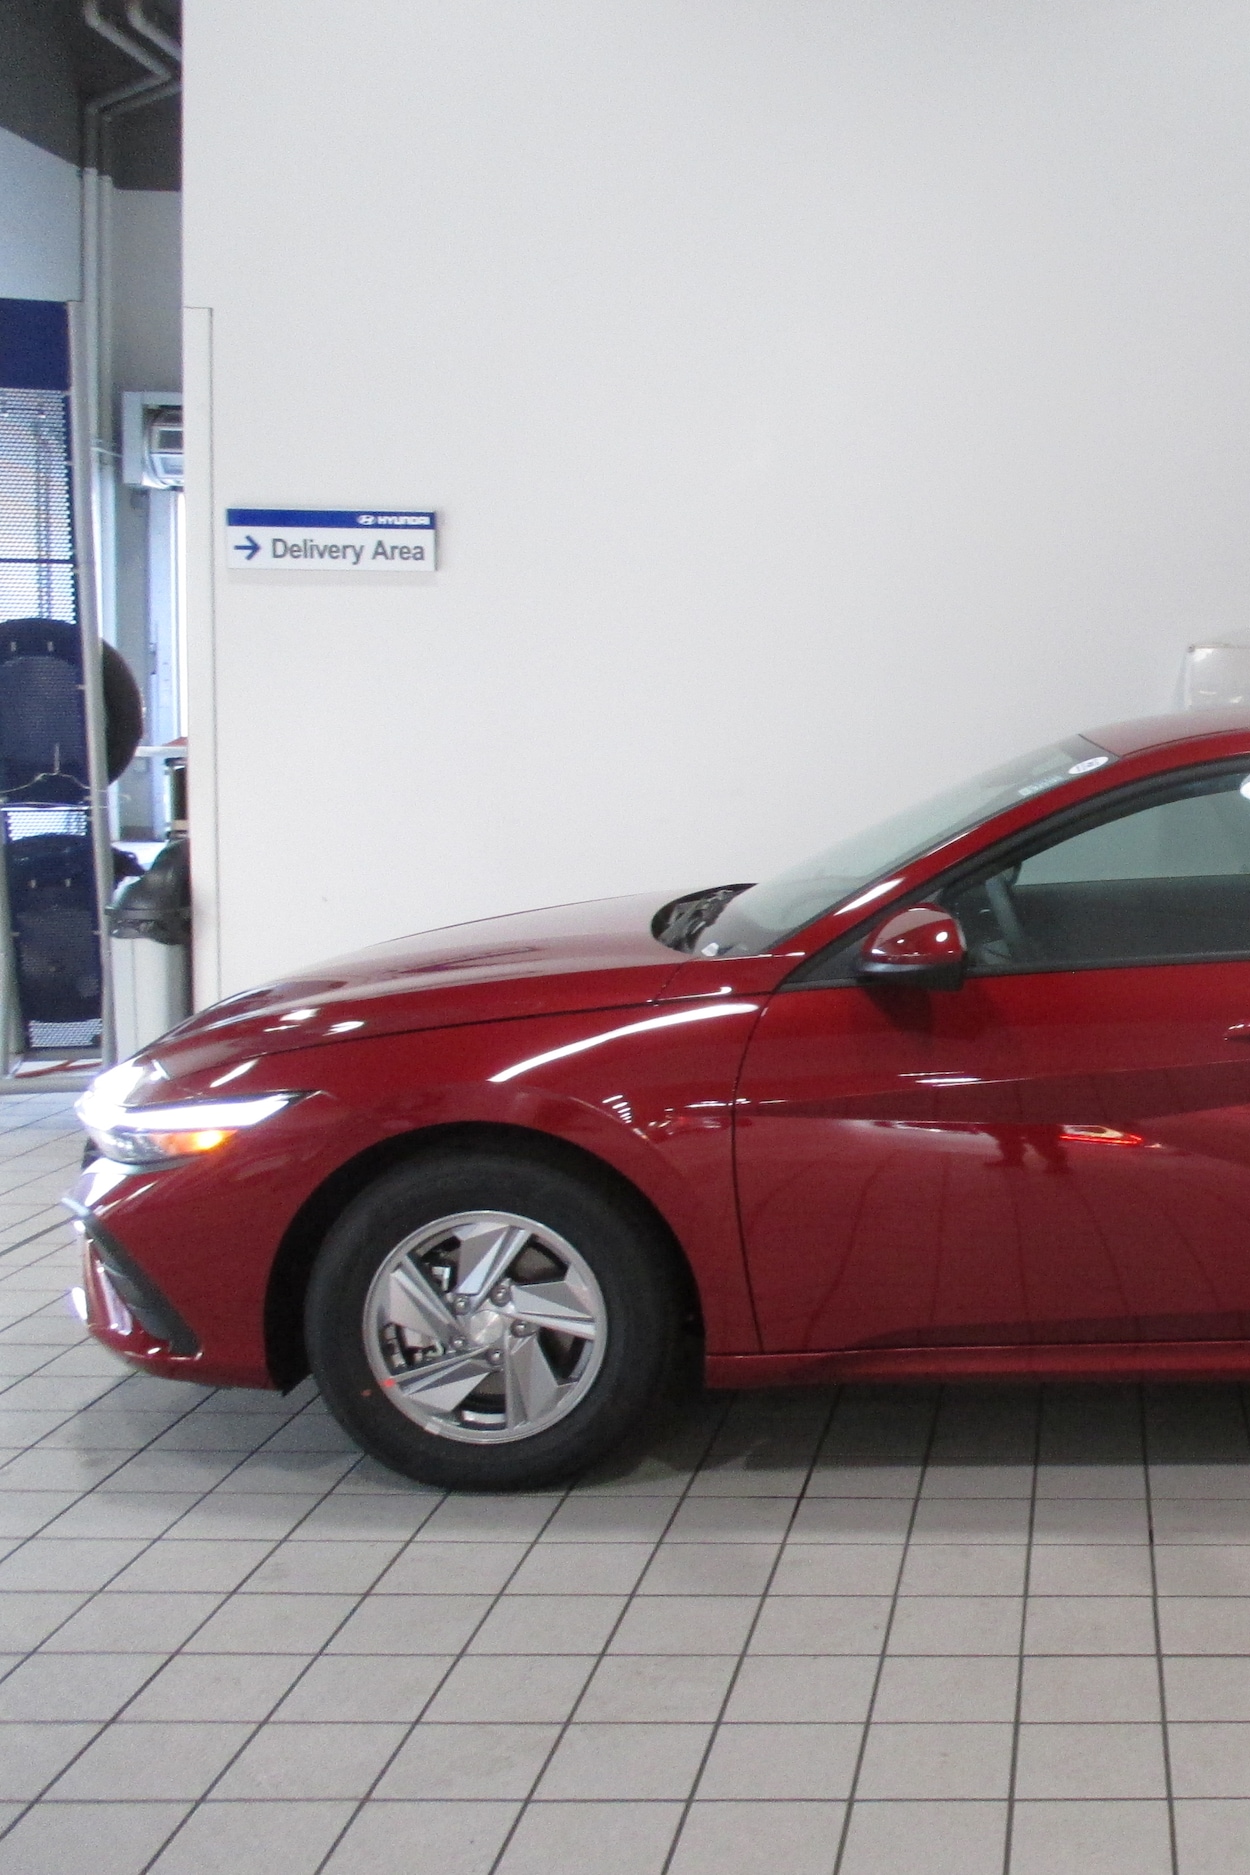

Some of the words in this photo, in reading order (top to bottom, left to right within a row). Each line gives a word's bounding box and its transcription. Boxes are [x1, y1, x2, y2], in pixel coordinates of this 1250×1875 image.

[377, 515, 431, 526] HYUNDAI
[271, 538, 364, 566] Delivery
[371, 539, 426, 562] Area
